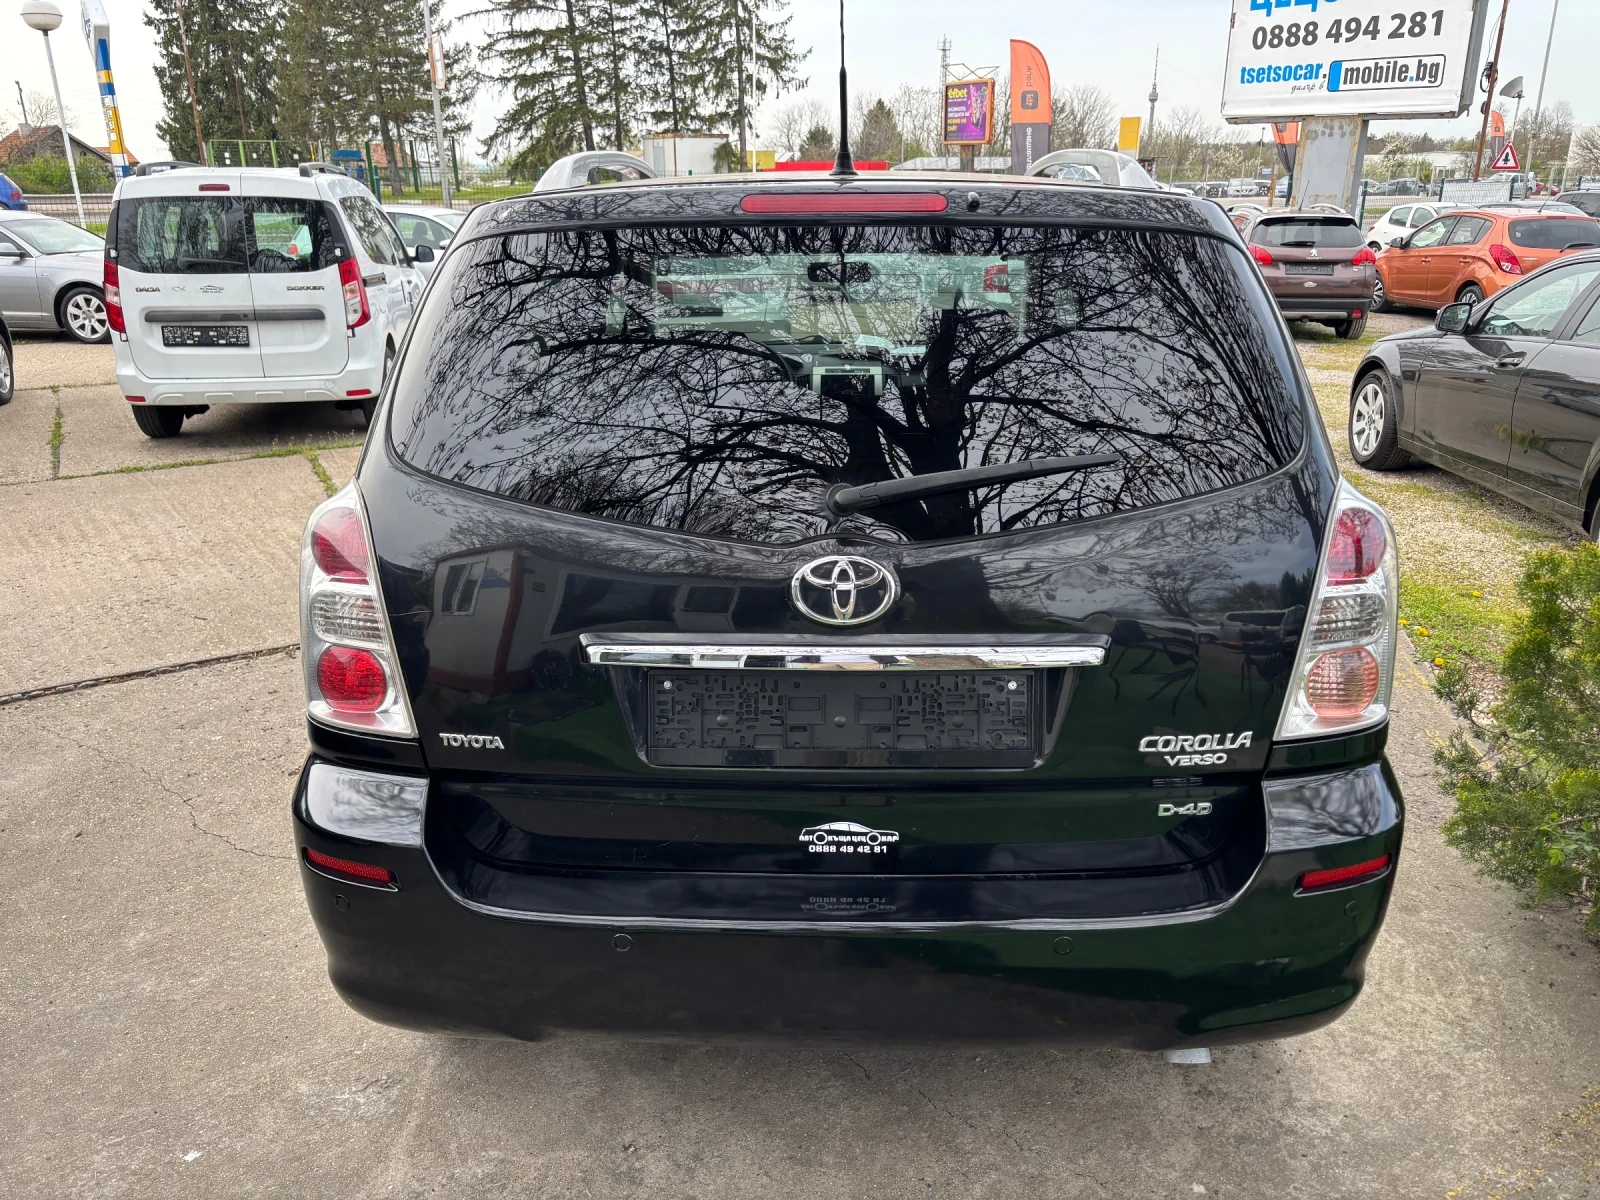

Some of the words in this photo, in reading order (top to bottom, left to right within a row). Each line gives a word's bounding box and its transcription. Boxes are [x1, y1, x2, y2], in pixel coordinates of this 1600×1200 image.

[1252, 20, 1319, 50] 0888
[1326, 15, 1380, 44] 494
[1388, 10, 1444, 39] 281
[1342, 59, 1441, 86] mobile.bg
[439, 732, 505, 749] TOYOTA
[1138, 731, 1253, 752] COROLLA
[1164, 753, 1227, 766] VERSO
[1158, 802, 1212, 817] D-4D
[808, 845, 837, 853] 0888
[839, 845, 854, 853] 49
[857, 845, 872, 853] 42
[873, 845, 887, 853] 81
